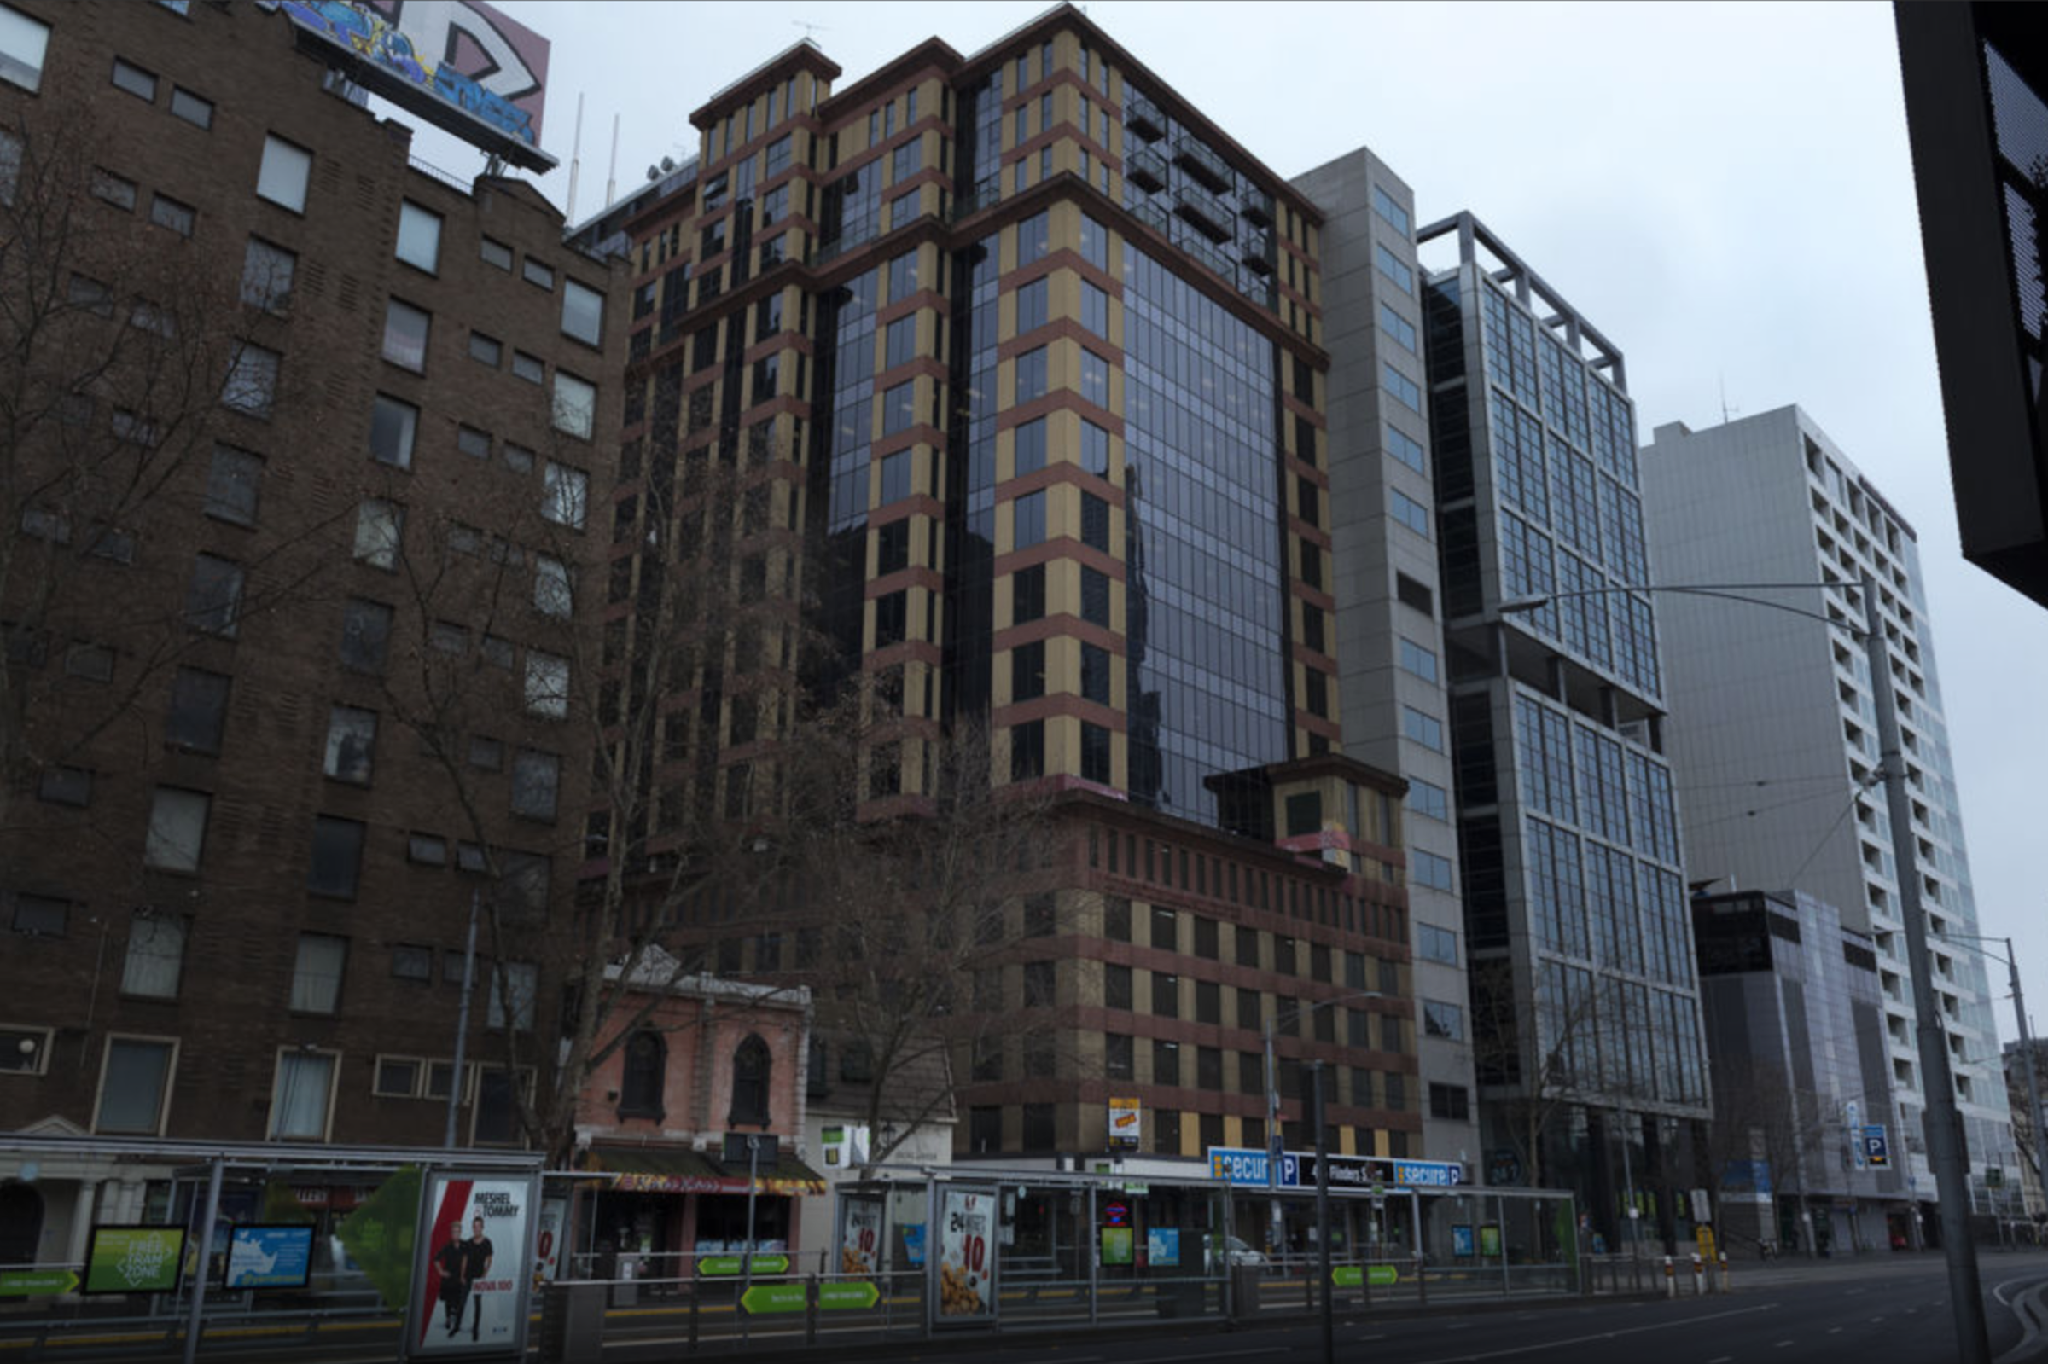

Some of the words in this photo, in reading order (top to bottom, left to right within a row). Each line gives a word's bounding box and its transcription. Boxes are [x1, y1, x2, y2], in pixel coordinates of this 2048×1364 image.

[1869, 1139, 1882, 1154] P
[1284, 1158, 1296, 1182] P
[1405, 1165, 1447, 1186] secure
[483, 1204, 520, 1217] TOMMY
[129, 1238, 162, 1253] FREE
[128, 1253, 163, 1267] TRAM
[125, 1265, 161, 1280] ZONE
